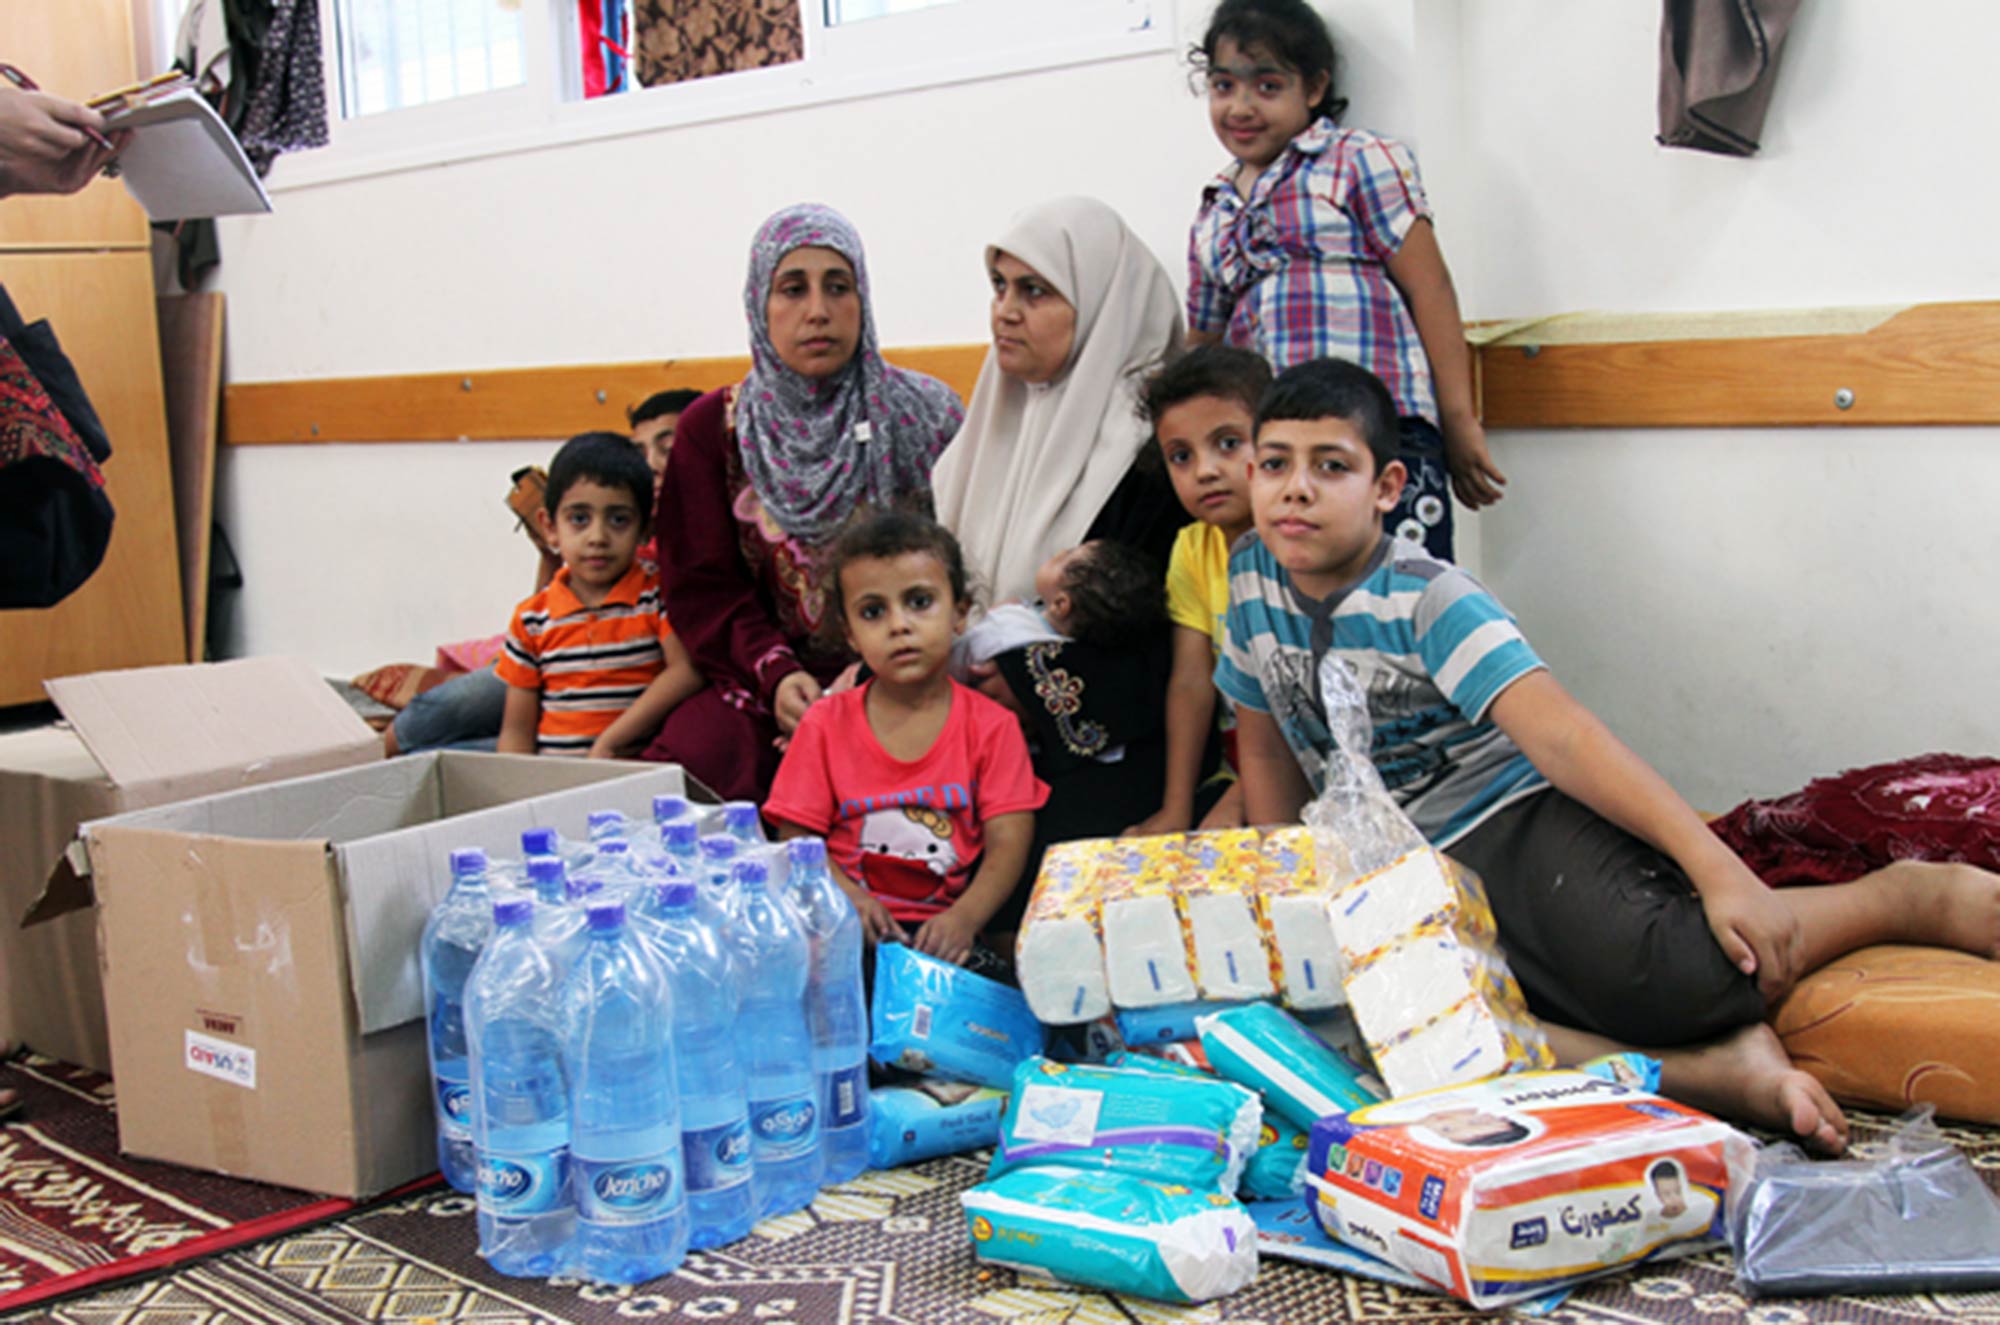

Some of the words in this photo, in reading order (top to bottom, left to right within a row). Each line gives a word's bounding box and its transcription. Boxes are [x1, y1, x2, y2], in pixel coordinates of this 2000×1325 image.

[190, 1046, 233, 1071] USAID
[602, 1170, 666, 1198] Jericho
[1560, 1194, 1642, 1239] كمفورت
